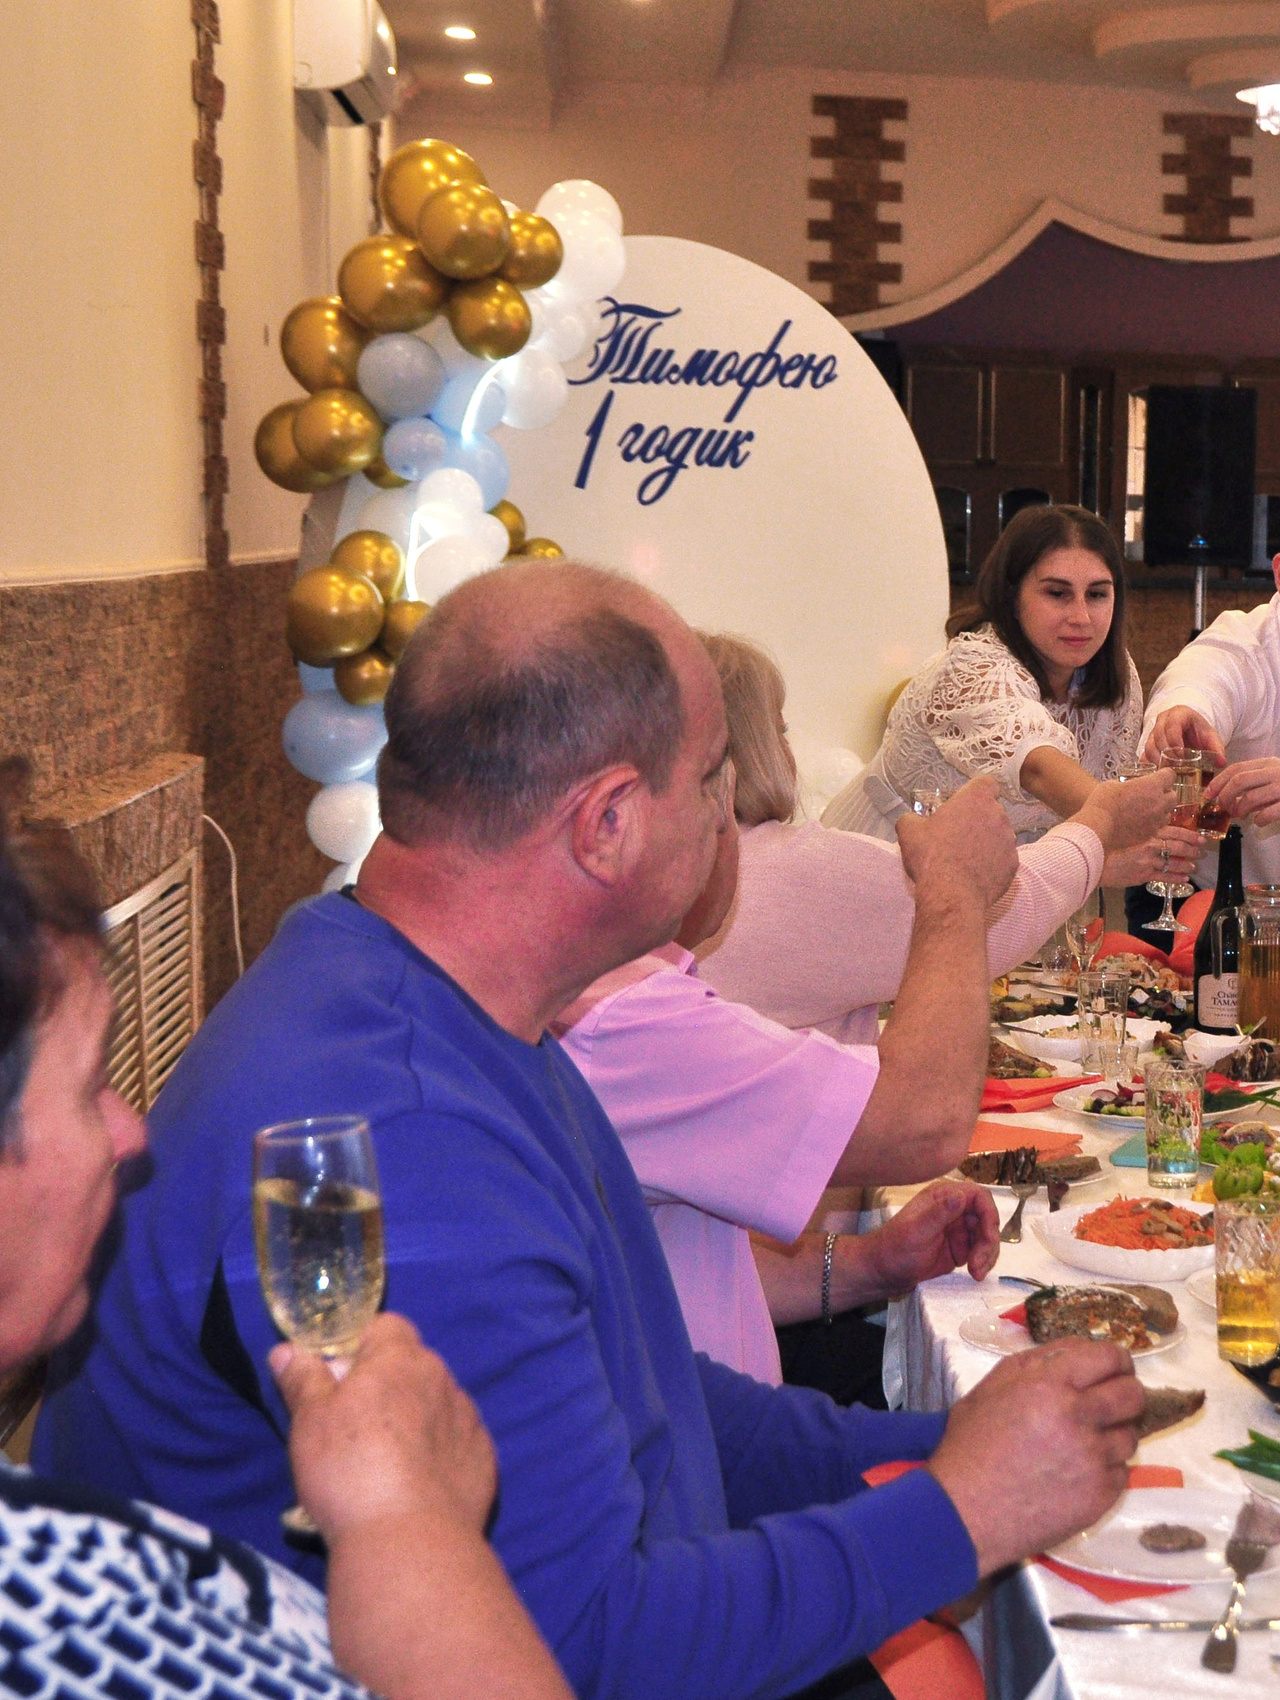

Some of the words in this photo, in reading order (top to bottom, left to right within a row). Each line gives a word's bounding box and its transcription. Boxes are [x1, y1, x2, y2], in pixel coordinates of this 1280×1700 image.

[568, 296, 838, 423] Тимофею
[574, 390, 615, 489] 1
[617, 423, 755, 506] годик
